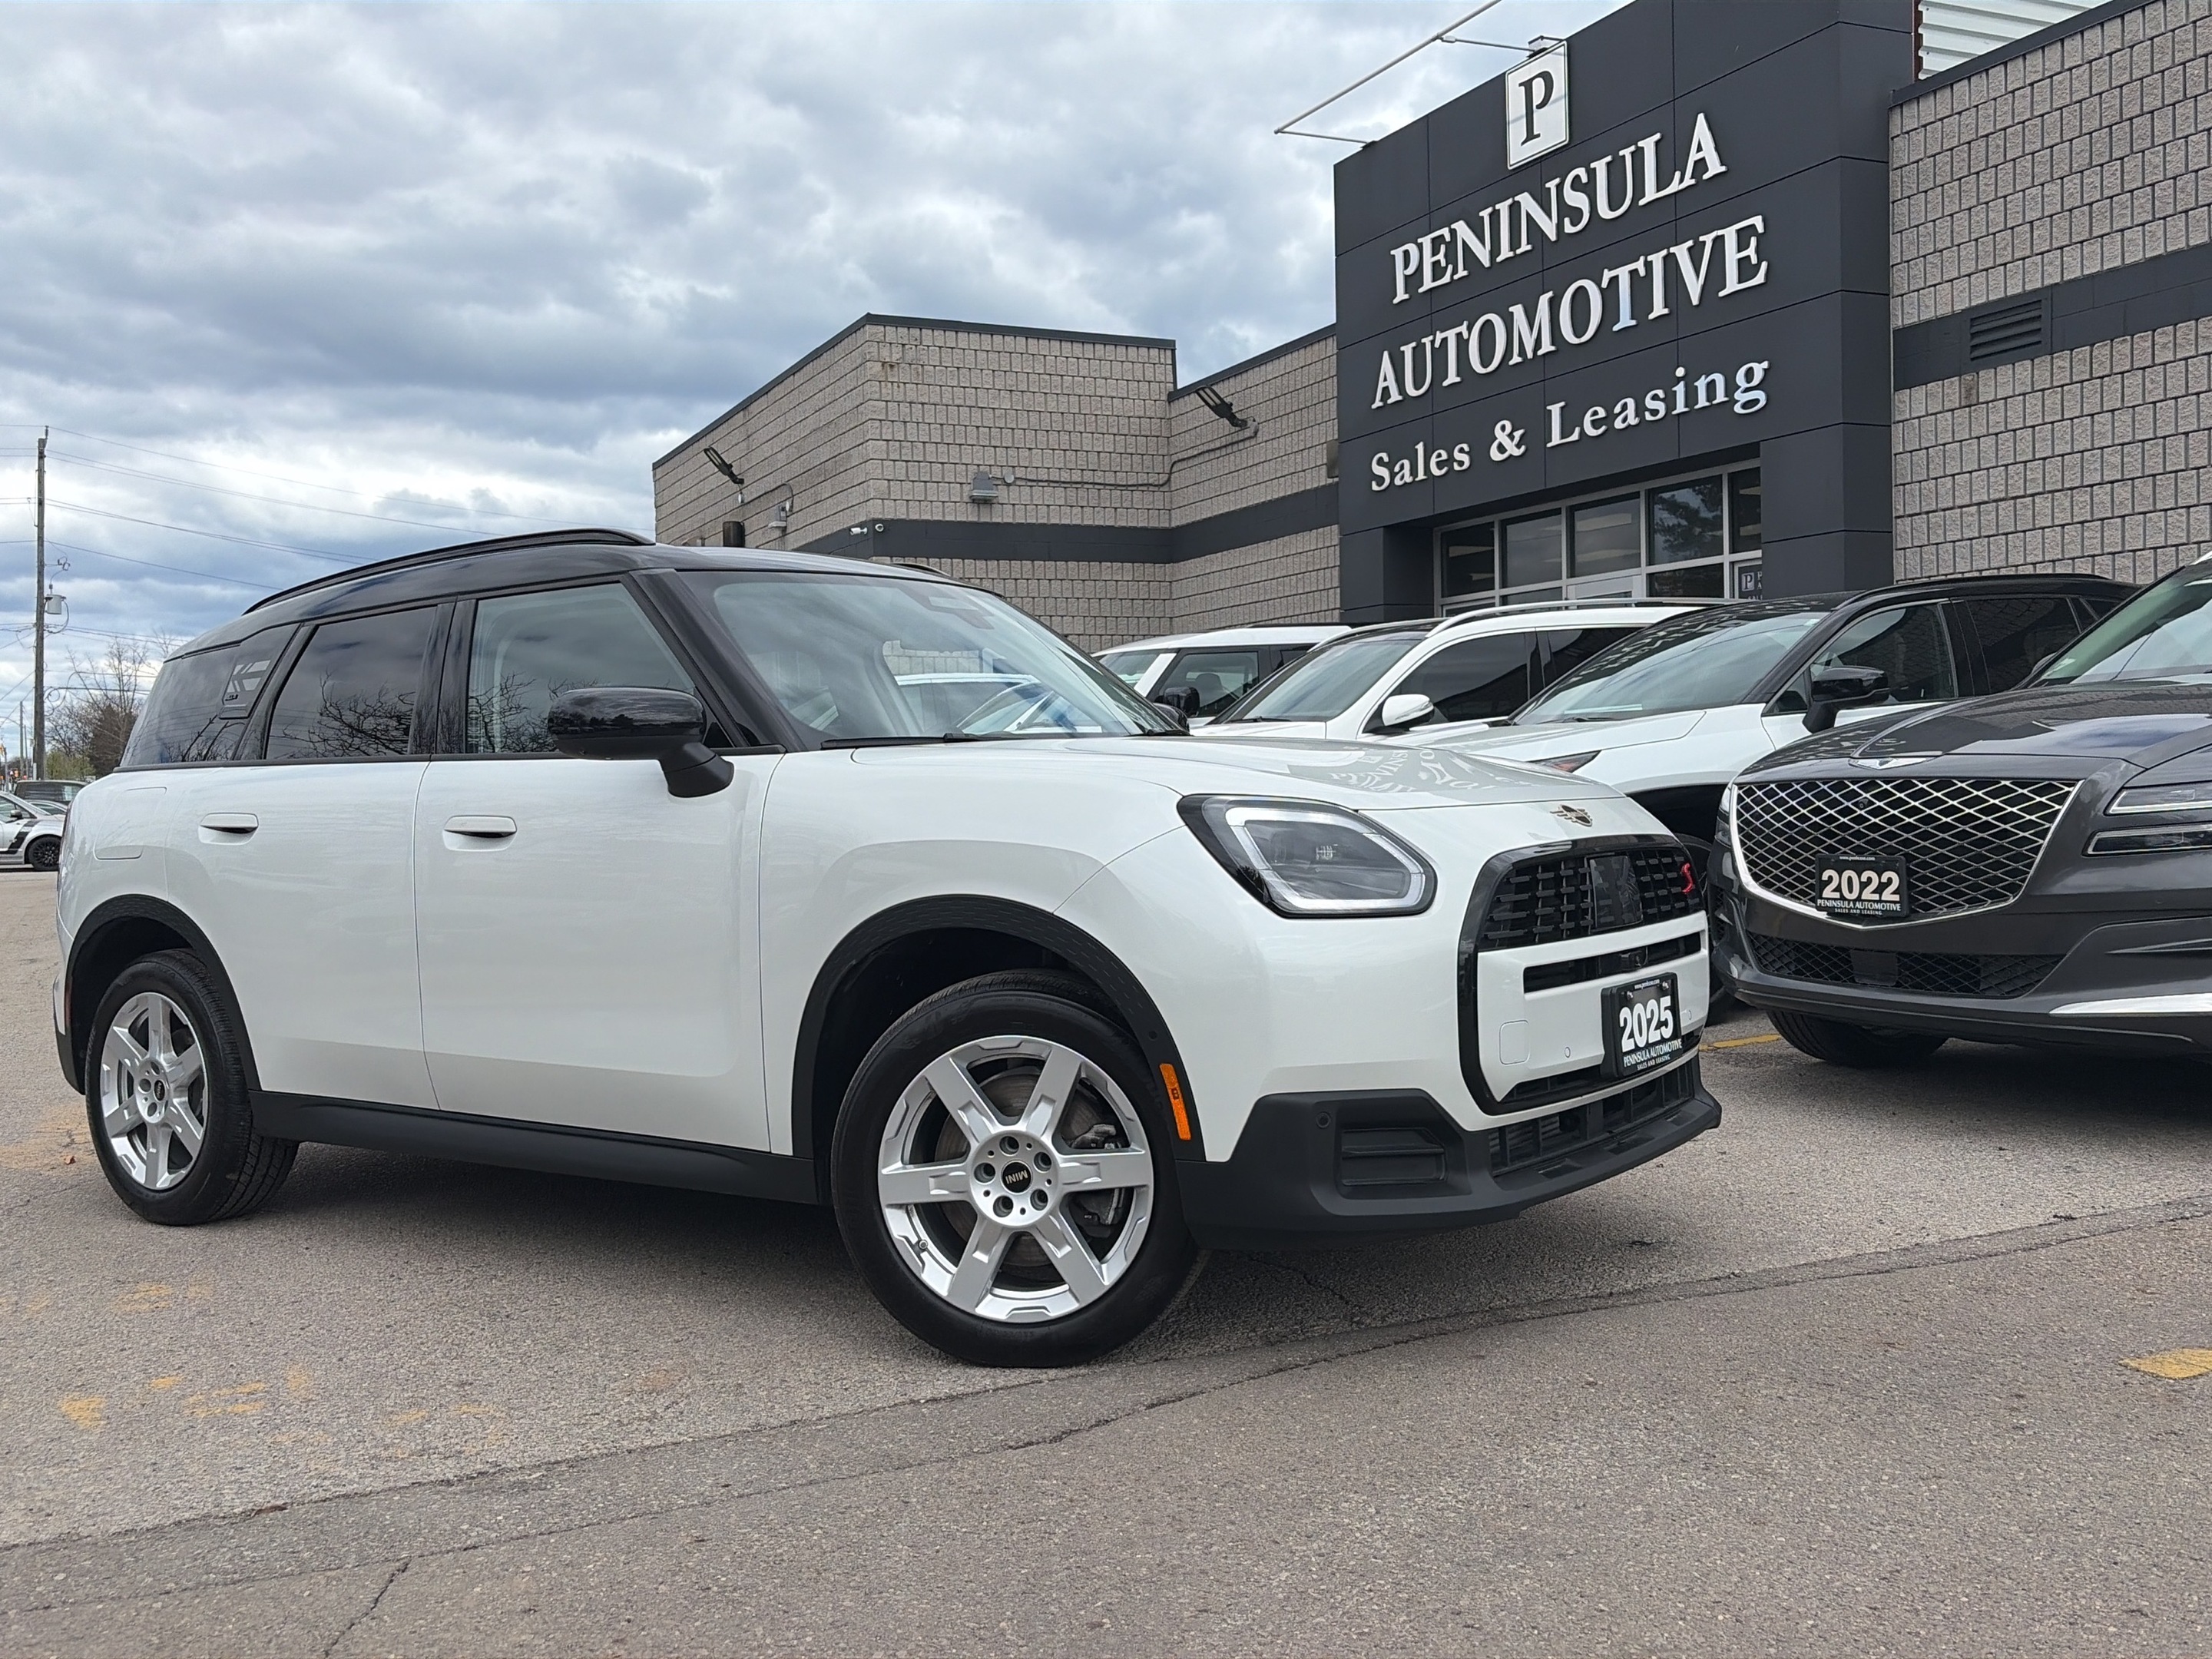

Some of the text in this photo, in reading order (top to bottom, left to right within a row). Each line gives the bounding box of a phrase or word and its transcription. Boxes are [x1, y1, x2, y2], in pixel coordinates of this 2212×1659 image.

[1518, 68, 1556, 147] P
[1389, 112, 1727, 305] PENINSULA
[1371, 214, 1769, 409] AUTOMOTIVE
[1370, 359, 1770, 492] Sales & Leasing
[1743, 574, 1753, 590] P
[1817, 899, 1902, 912] PENINSULA AUTOMOTIVE
[1821, 869, 1900, 901] 2022
[1619, 995, 1674, 1053] 2025
[1623, 1038, 1682, 1068] PENINSULA AUTOMOTIVE
[1005, 1169, 1028, 1184] MINI
